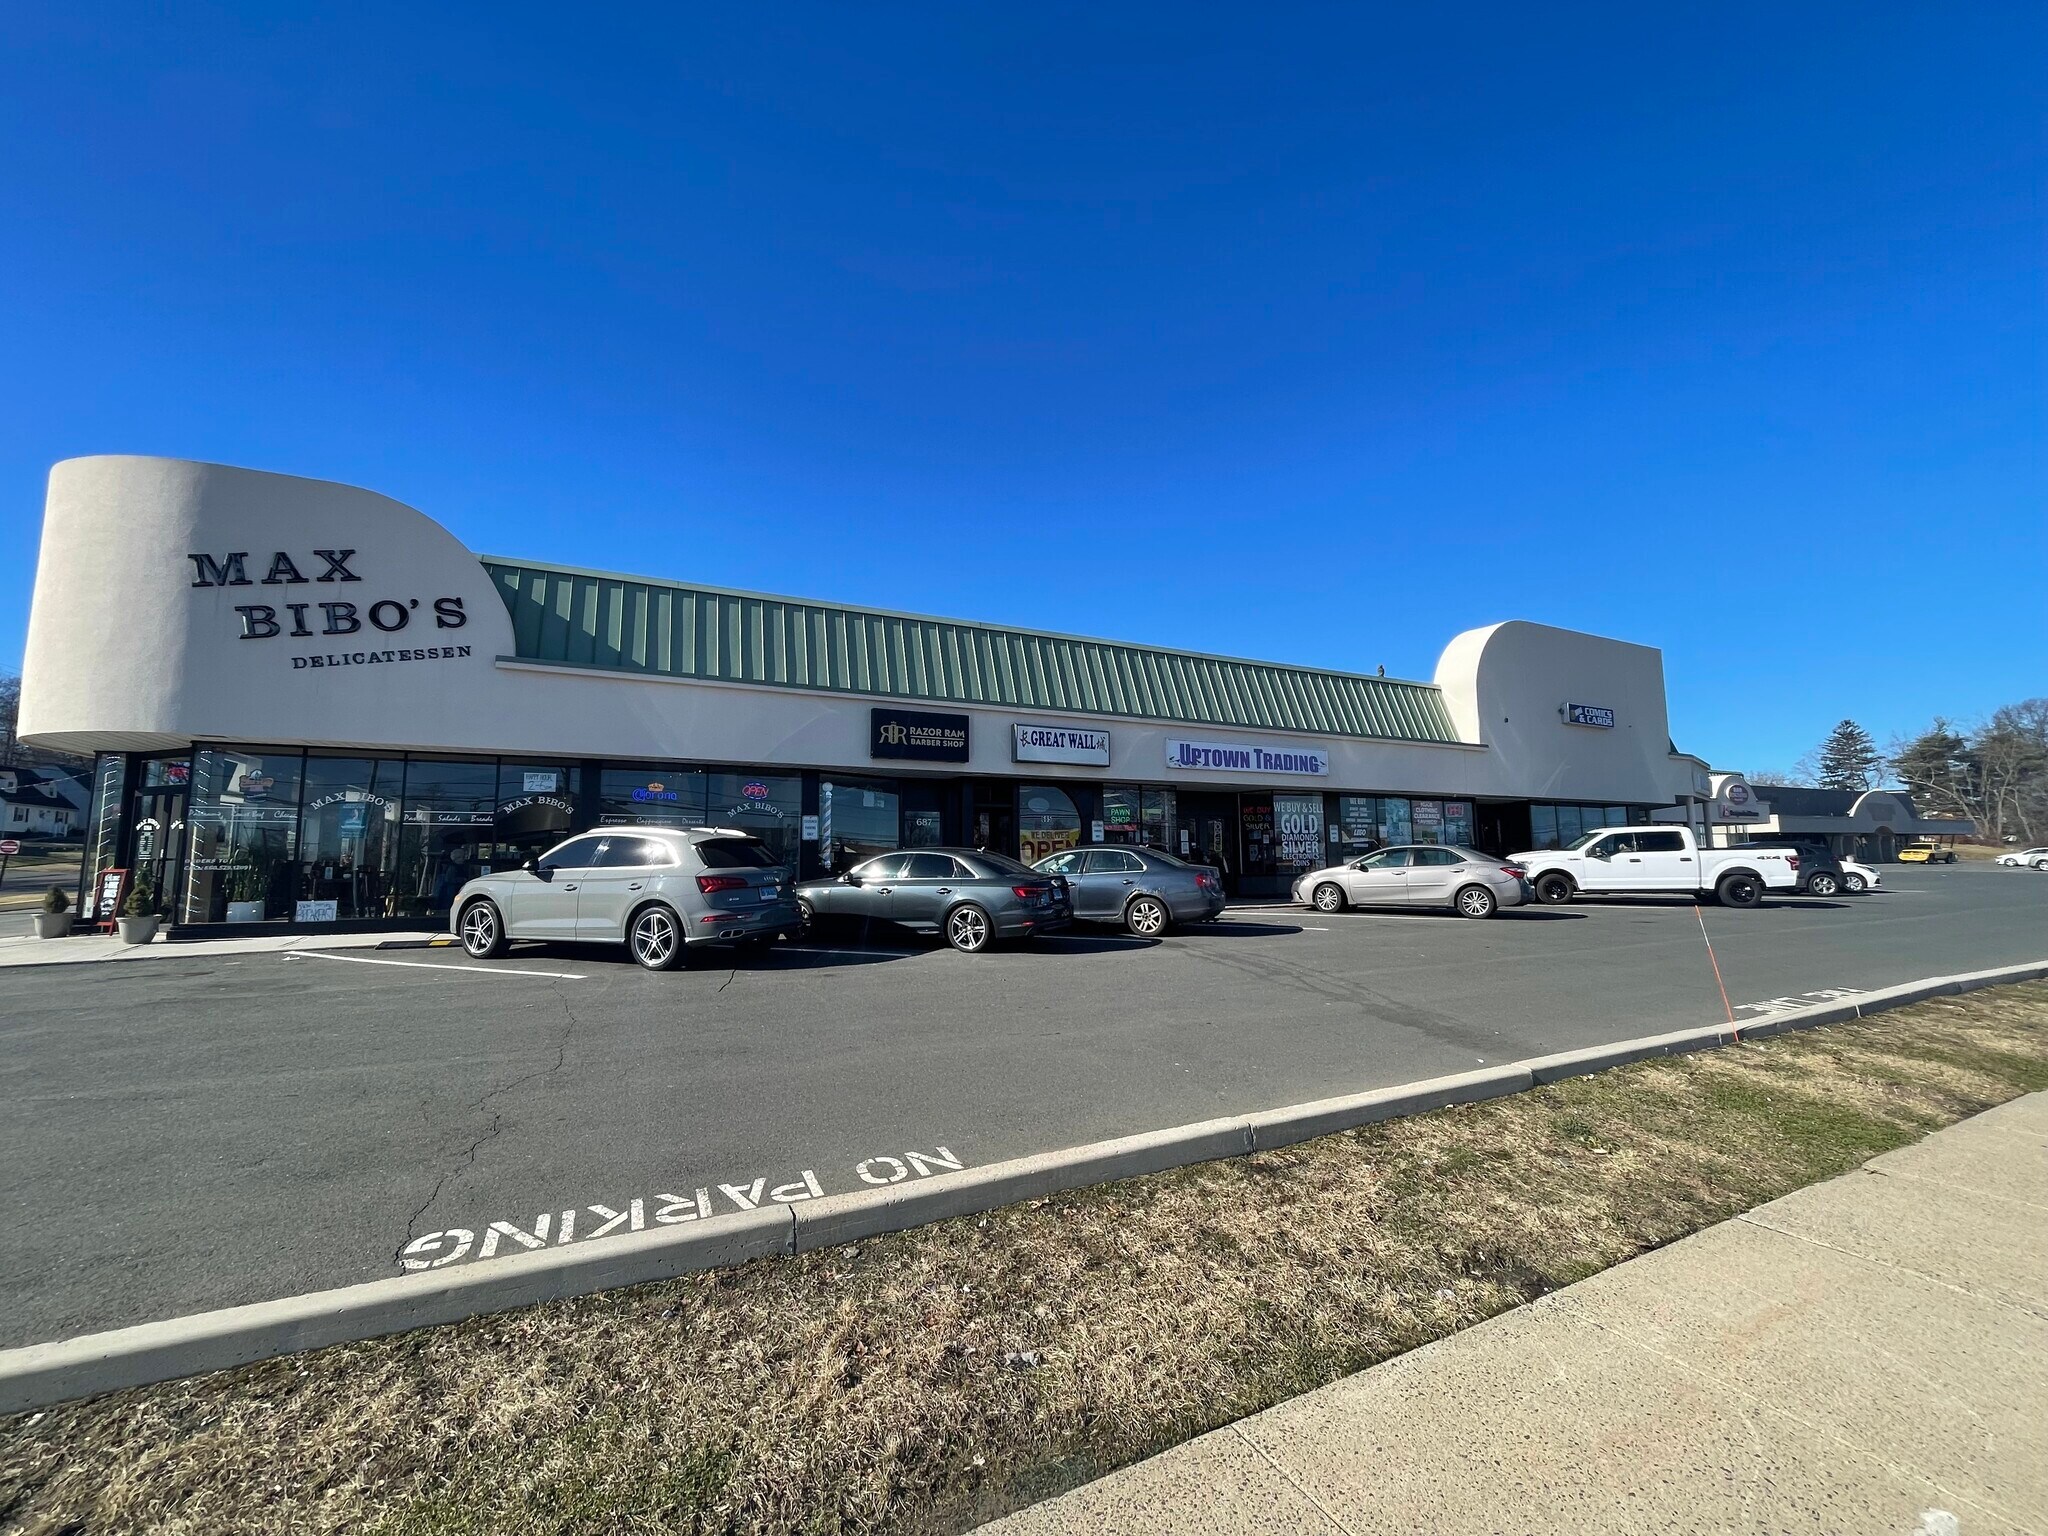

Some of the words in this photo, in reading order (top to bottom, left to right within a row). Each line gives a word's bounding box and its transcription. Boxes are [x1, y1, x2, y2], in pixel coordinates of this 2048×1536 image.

[188, 549, 361, 587] MAX
[234, 597, 467, 639] BIBO'S
[291, 645, 472, 669] DELICATESSEN
[1584, 708, 1612, 718] COMICS
[1579, 714, 1586, 722] &
[1586, 716, 1612, 726] CARDS
[910, 726, 942, 737] RAZOR
[944, 729, 965, 738] RAM
[910, 738, 941, 747] BARBER
[942, 740, 964, 748] SHOP
[1030, 730, 1066, 748] GREAT
[1068, 732, 1096, 750] WALL
[1179, 744, 1250, 768] UPTOWN
[1253, 748, 1320, 772] TRADING
[632, 788, 678, 802] Corona
[742, 785, 769, 796] OPEN
[310, 792, 346, 810] MAX
[350, 792, 393, 812] IBO'S
[503, 796, 534, 814] MAX
[537, 796, 575, 815] BIBO'S
[1274, 802, 1285, 812] WE
[1286, 802, 1300, 813] BUY
[1302, 803, 1308, 813] &
[1308, 803, 1324, 813] SELL
[727, 802, 752, 818] MAX
[754, 802, 785, 819] BIBO'S
[1110, 808, 1131, 816] PAWN
[438, 814, 461, 822] Salads
[600, 816, 627, 824] Espresso
[916, 818, 932, 826] 687
[1110, 816, 1131, 824] SHOP
[1243, 814, 1264, 822] GOLD
[1281, 814, 1318, 834] GOLD
[1246, 822, 1270, 830] SILVER
[1282, 834, 1319, 842] DIAMONDS
[1282, 842, 1319, 853] SILVER
[854, 1145, 966, 1185] NO
[401, 1169, 825, 1269] PARKING
